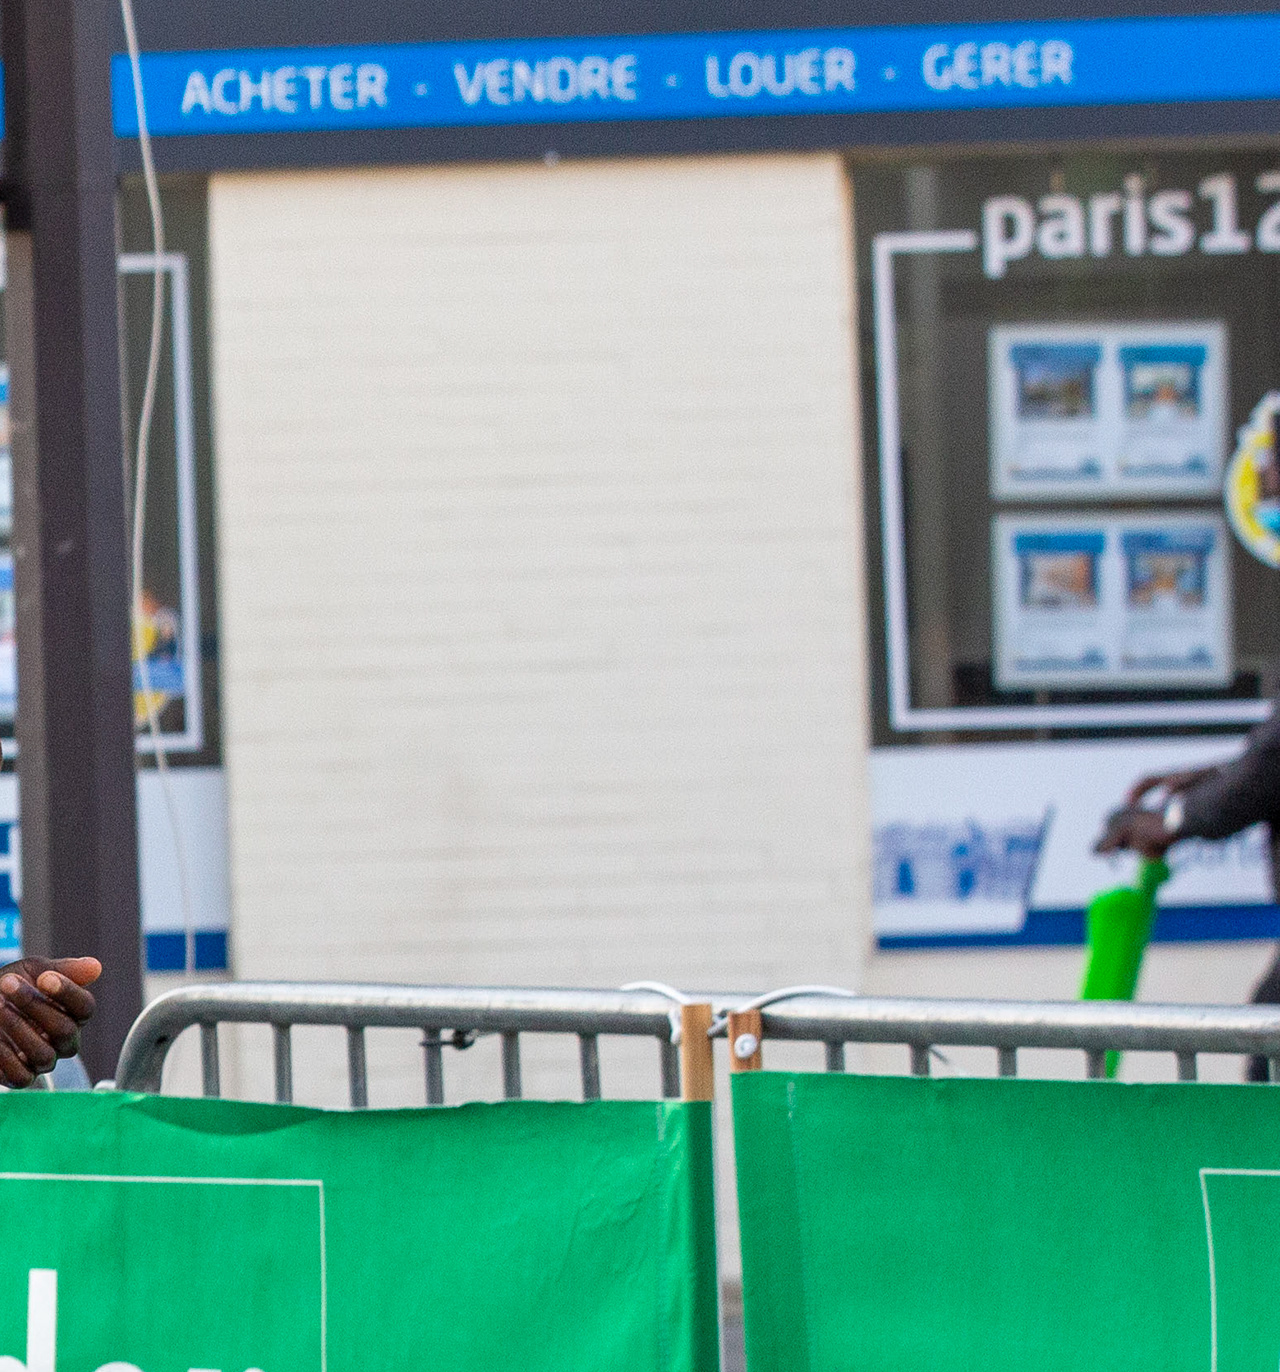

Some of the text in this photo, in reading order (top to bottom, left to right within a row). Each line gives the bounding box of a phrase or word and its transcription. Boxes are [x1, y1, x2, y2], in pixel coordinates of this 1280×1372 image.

[181, 63, 388, 116] ACHETER
[452, 54, 638, 107] VENDRE
[705, 47, 856, 99] LOUER
